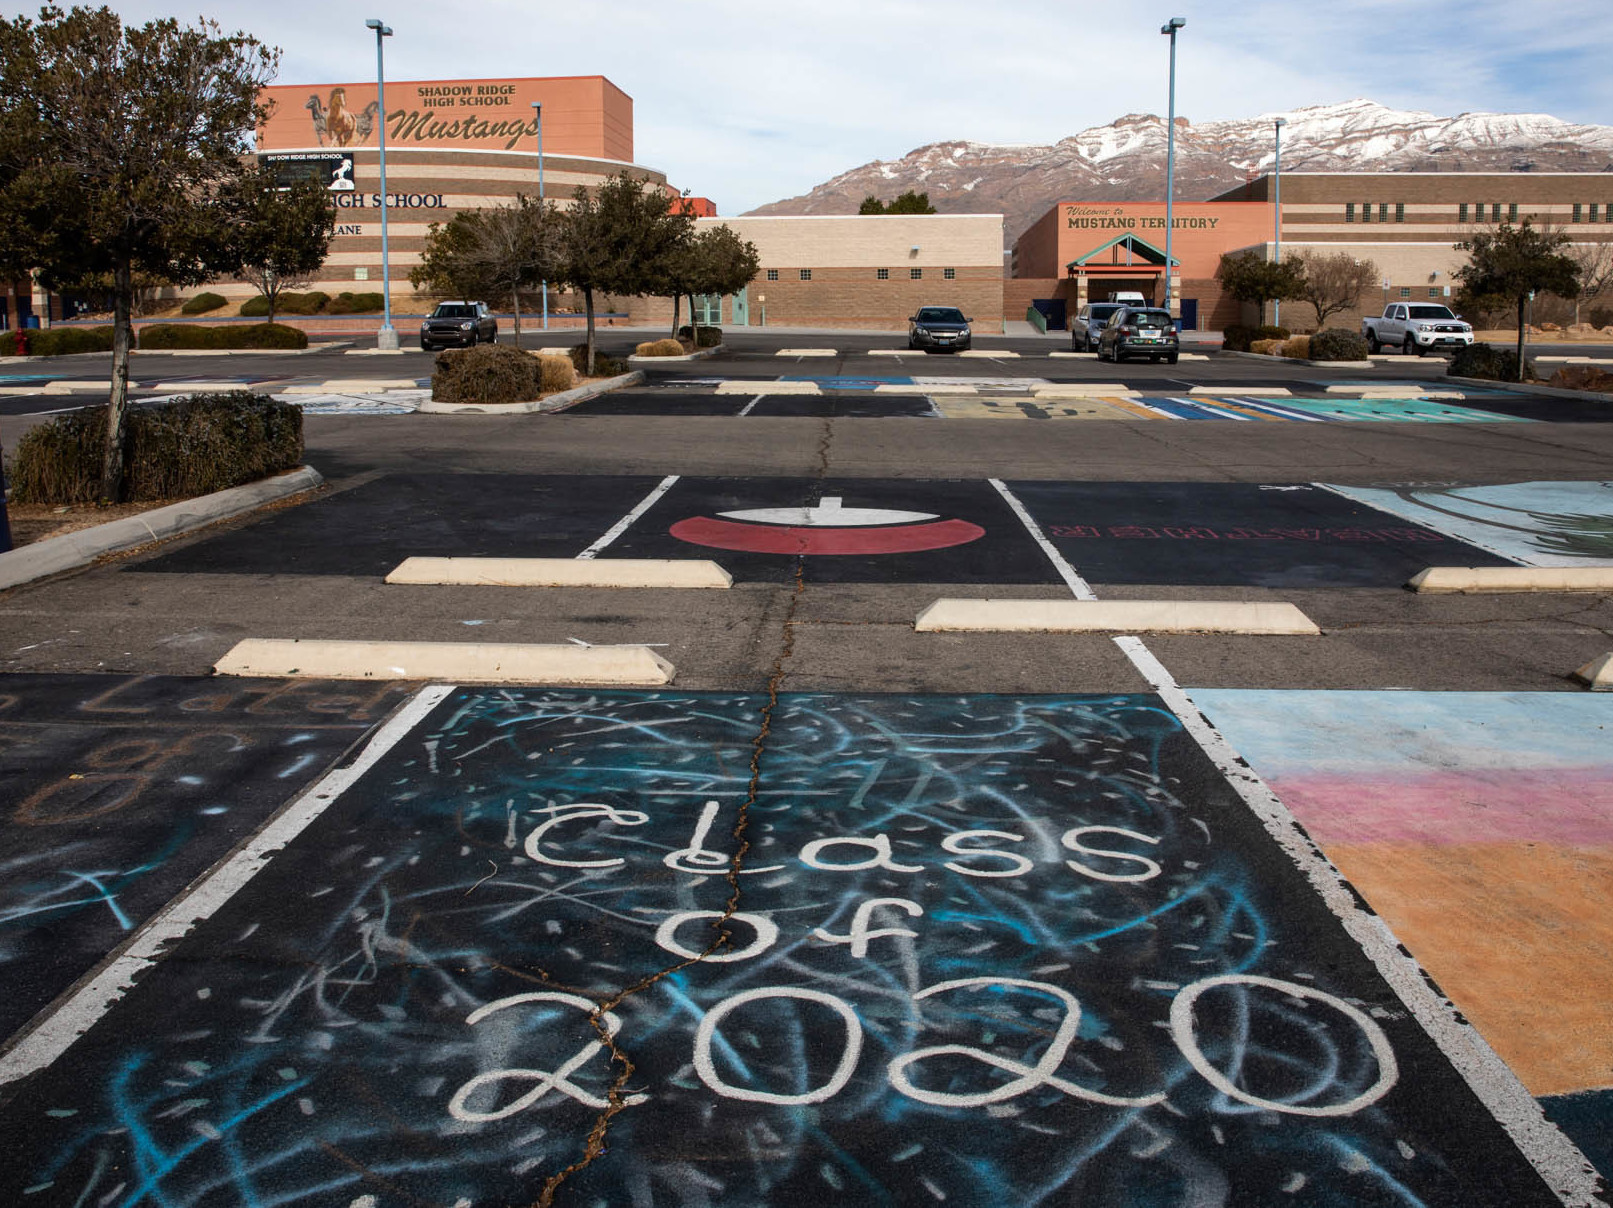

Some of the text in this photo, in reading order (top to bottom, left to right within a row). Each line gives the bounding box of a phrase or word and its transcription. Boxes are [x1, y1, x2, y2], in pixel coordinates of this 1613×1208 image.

[418, 84, 516, 97] SHADOW RIDGE
[423, 96, 511, 108] HIGH SCHOOL
[386, 109, 540, 151] Mustangs
[331, 193, 365, 208] IGH
[1066, 206, 1124, 216] Welcome to
[1068, 217, 1136, 229] MUSTANG
[524, 800, 1162, 884] Class
[655, 896, 924, 963] of
[447, 973, 1400, 1123] 2020
